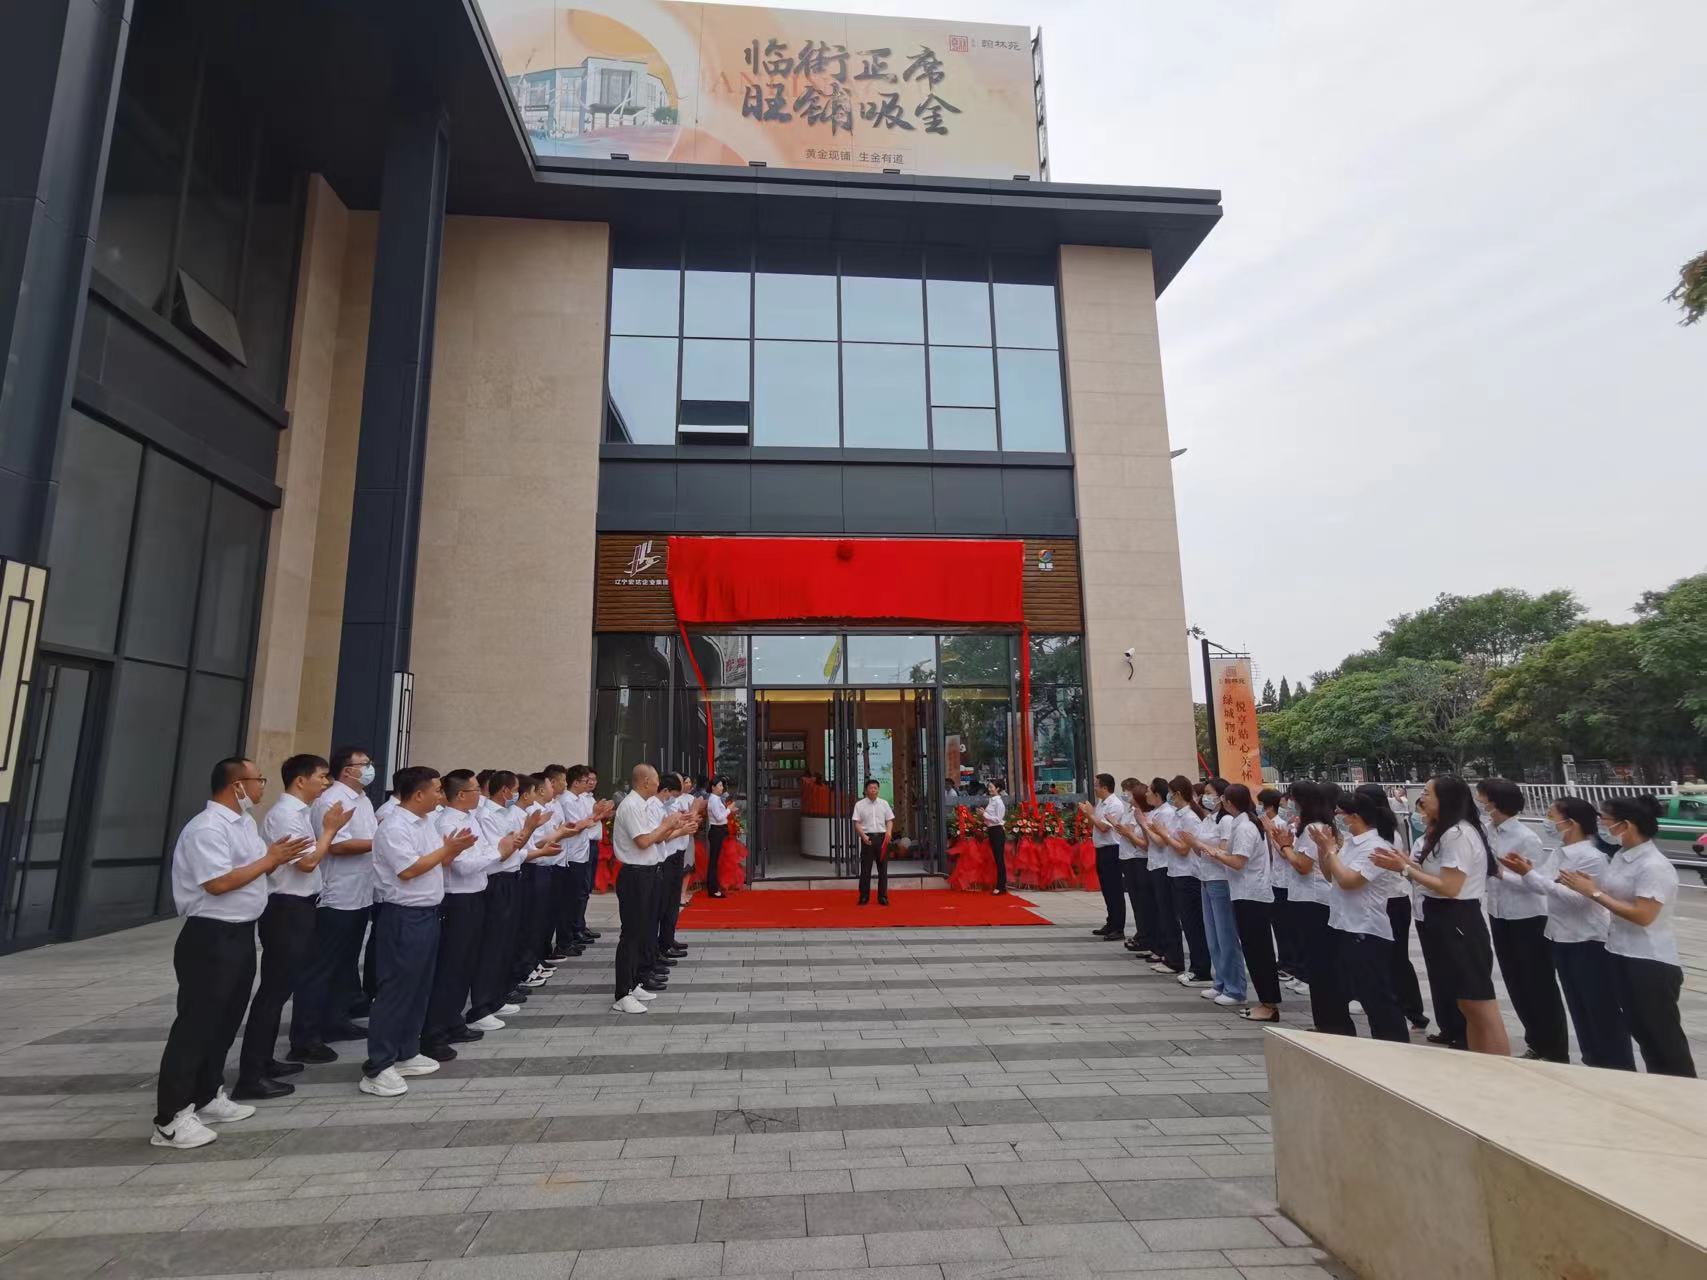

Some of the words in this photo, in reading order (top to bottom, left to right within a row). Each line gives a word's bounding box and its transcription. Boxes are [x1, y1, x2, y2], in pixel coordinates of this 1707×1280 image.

[805, 148, 851, 161] 黄金现铺
[859, 151, 904, 164] 生金有道
[1222, 694, 1237, 746] 绿城物业
